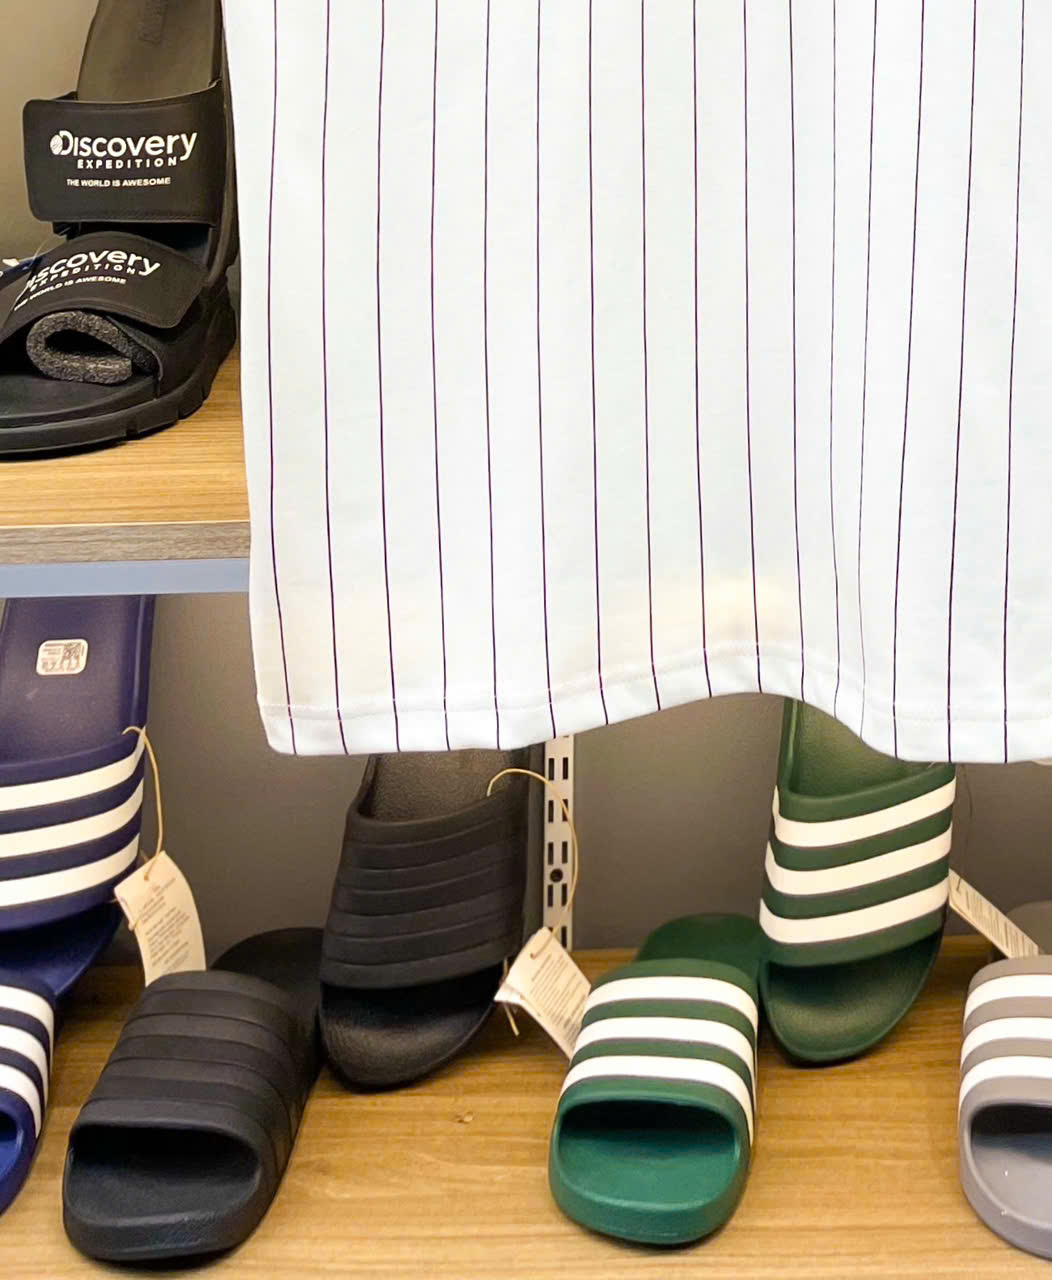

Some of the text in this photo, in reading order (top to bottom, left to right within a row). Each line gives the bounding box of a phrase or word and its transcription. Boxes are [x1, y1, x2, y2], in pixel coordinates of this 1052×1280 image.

[77, 157, 177, 169] EXPEDITION
[66, 177, 171, 187] THE WORLD IS AWESOME
[75, 276, 127, 285] AWESOME
